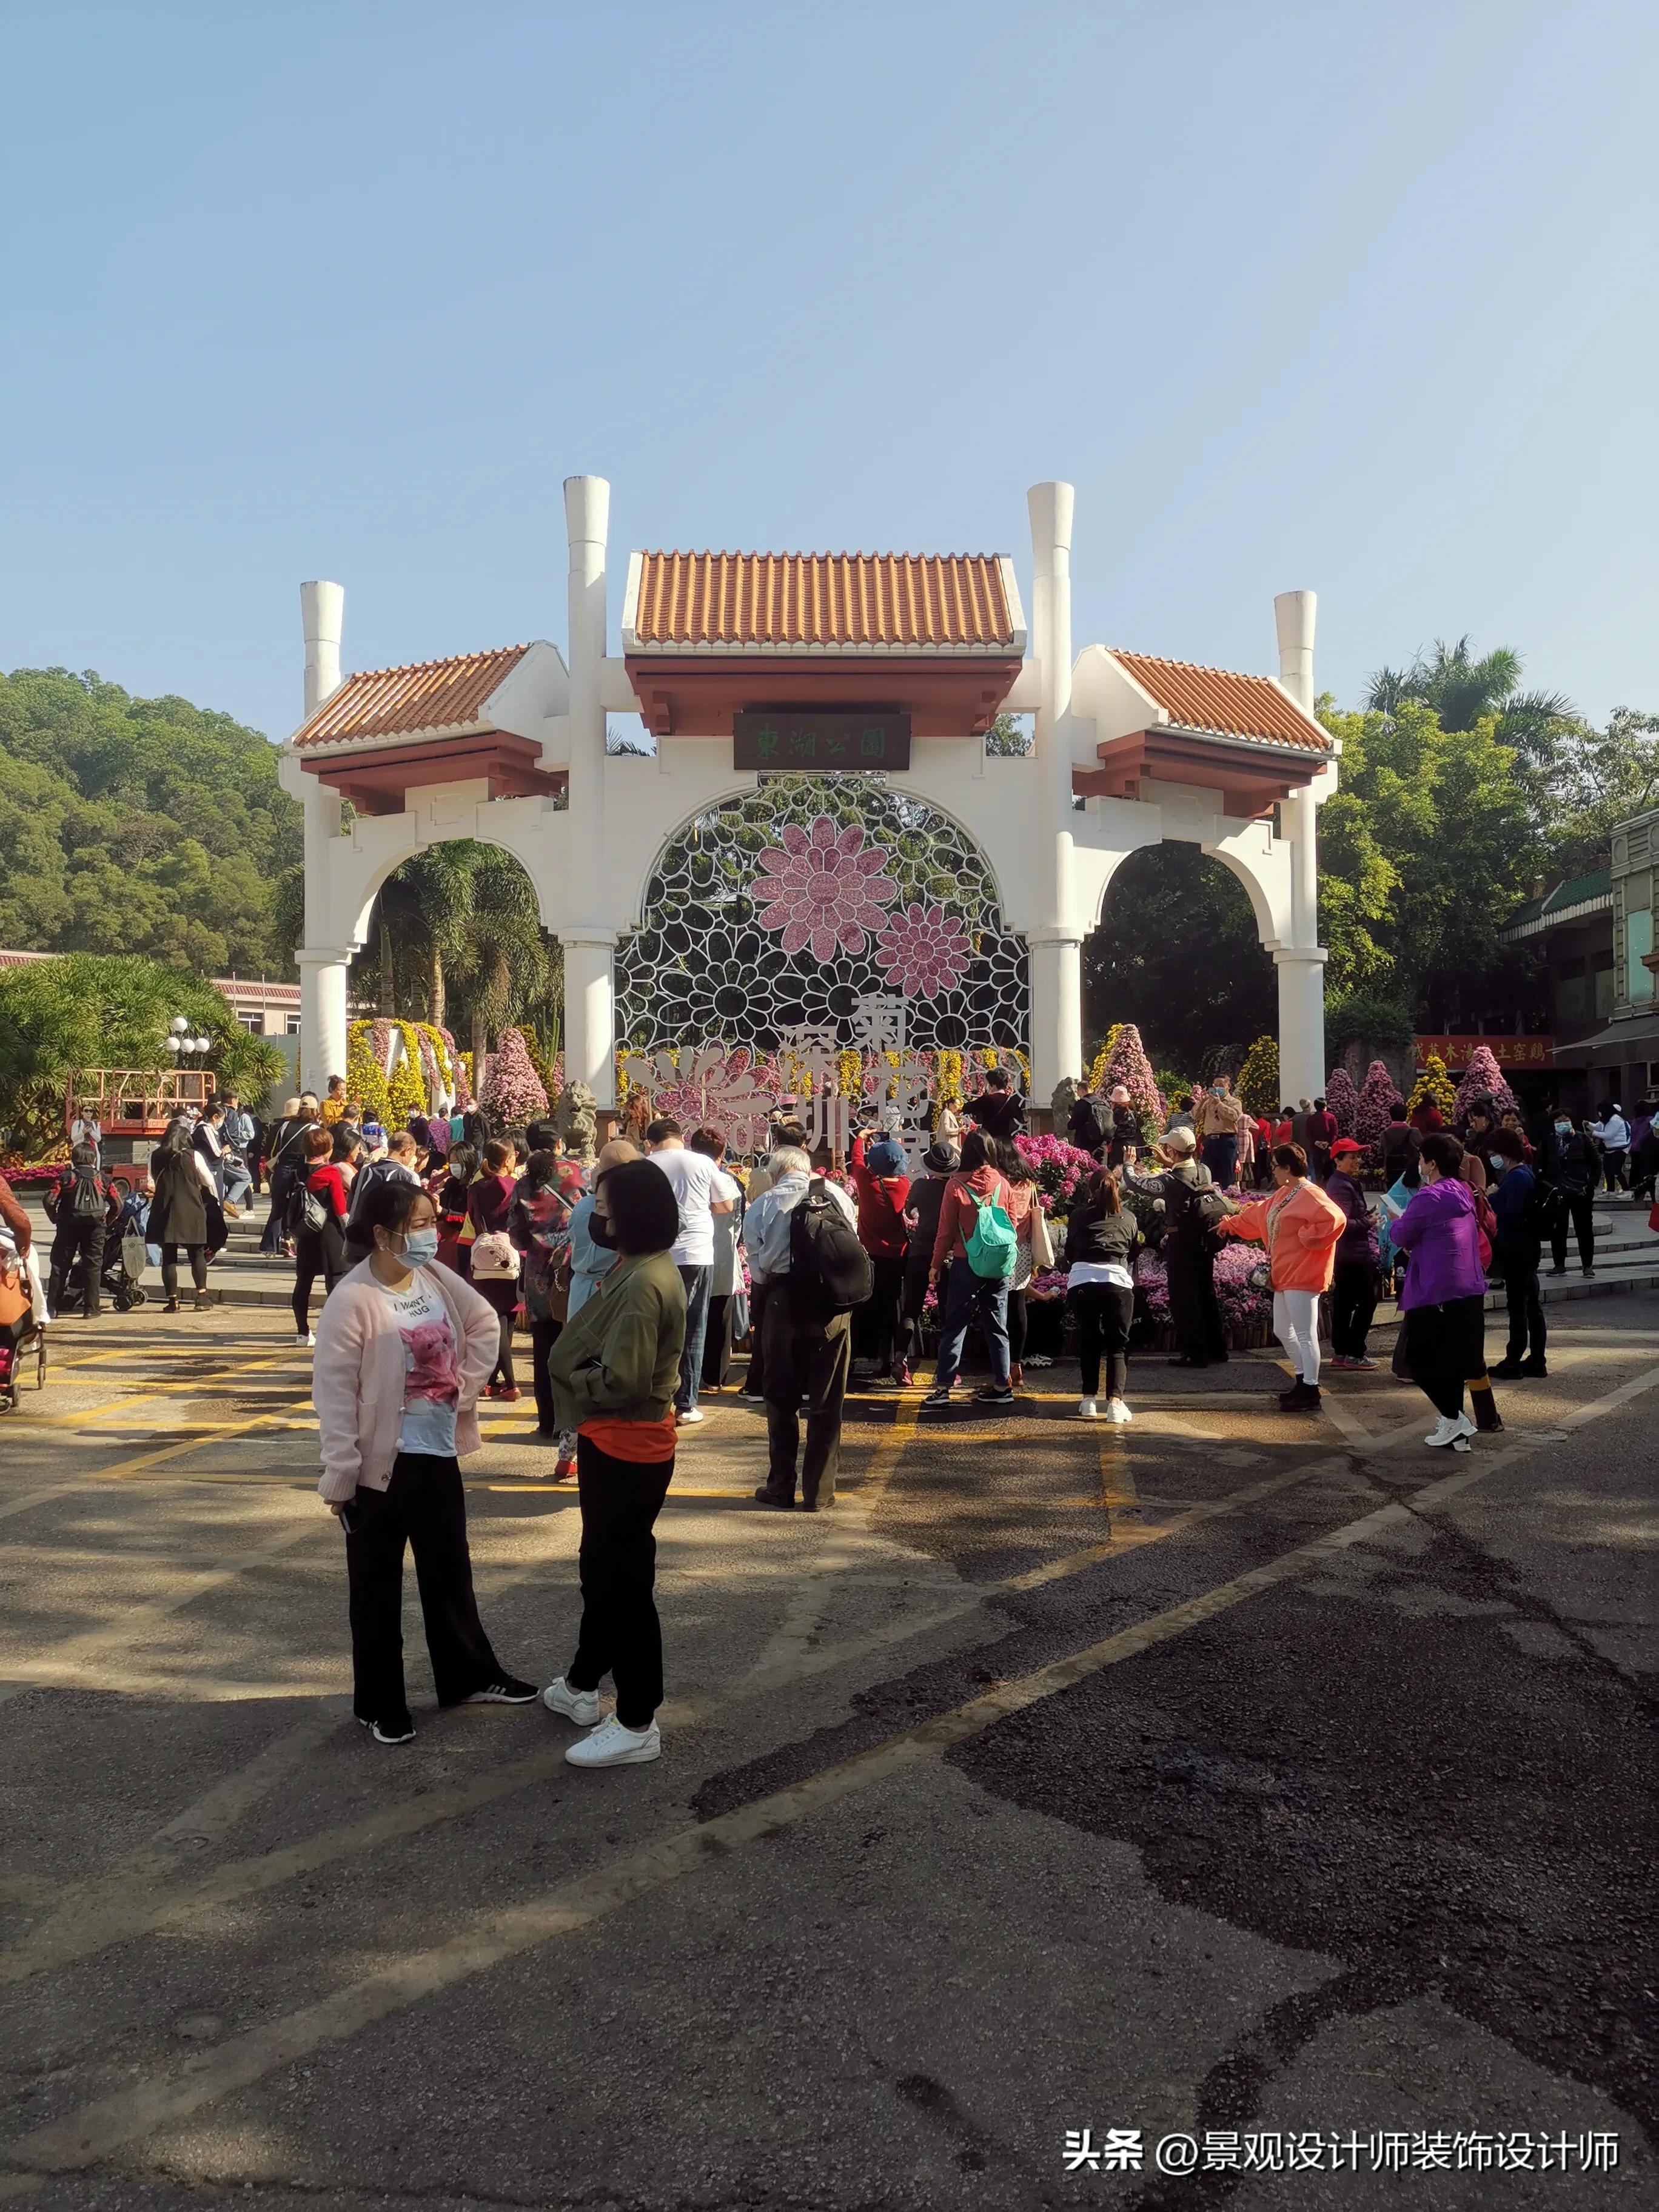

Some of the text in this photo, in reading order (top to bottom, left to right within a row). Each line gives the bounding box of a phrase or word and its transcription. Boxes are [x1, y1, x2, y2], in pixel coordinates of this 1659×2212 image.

[779, 1024, 850, 1152] 深圳
[394, 1303, 398, 1312] I
[400, 1295, 425, 1310] WANT
[408, 1305, 431, 1318] HUG
